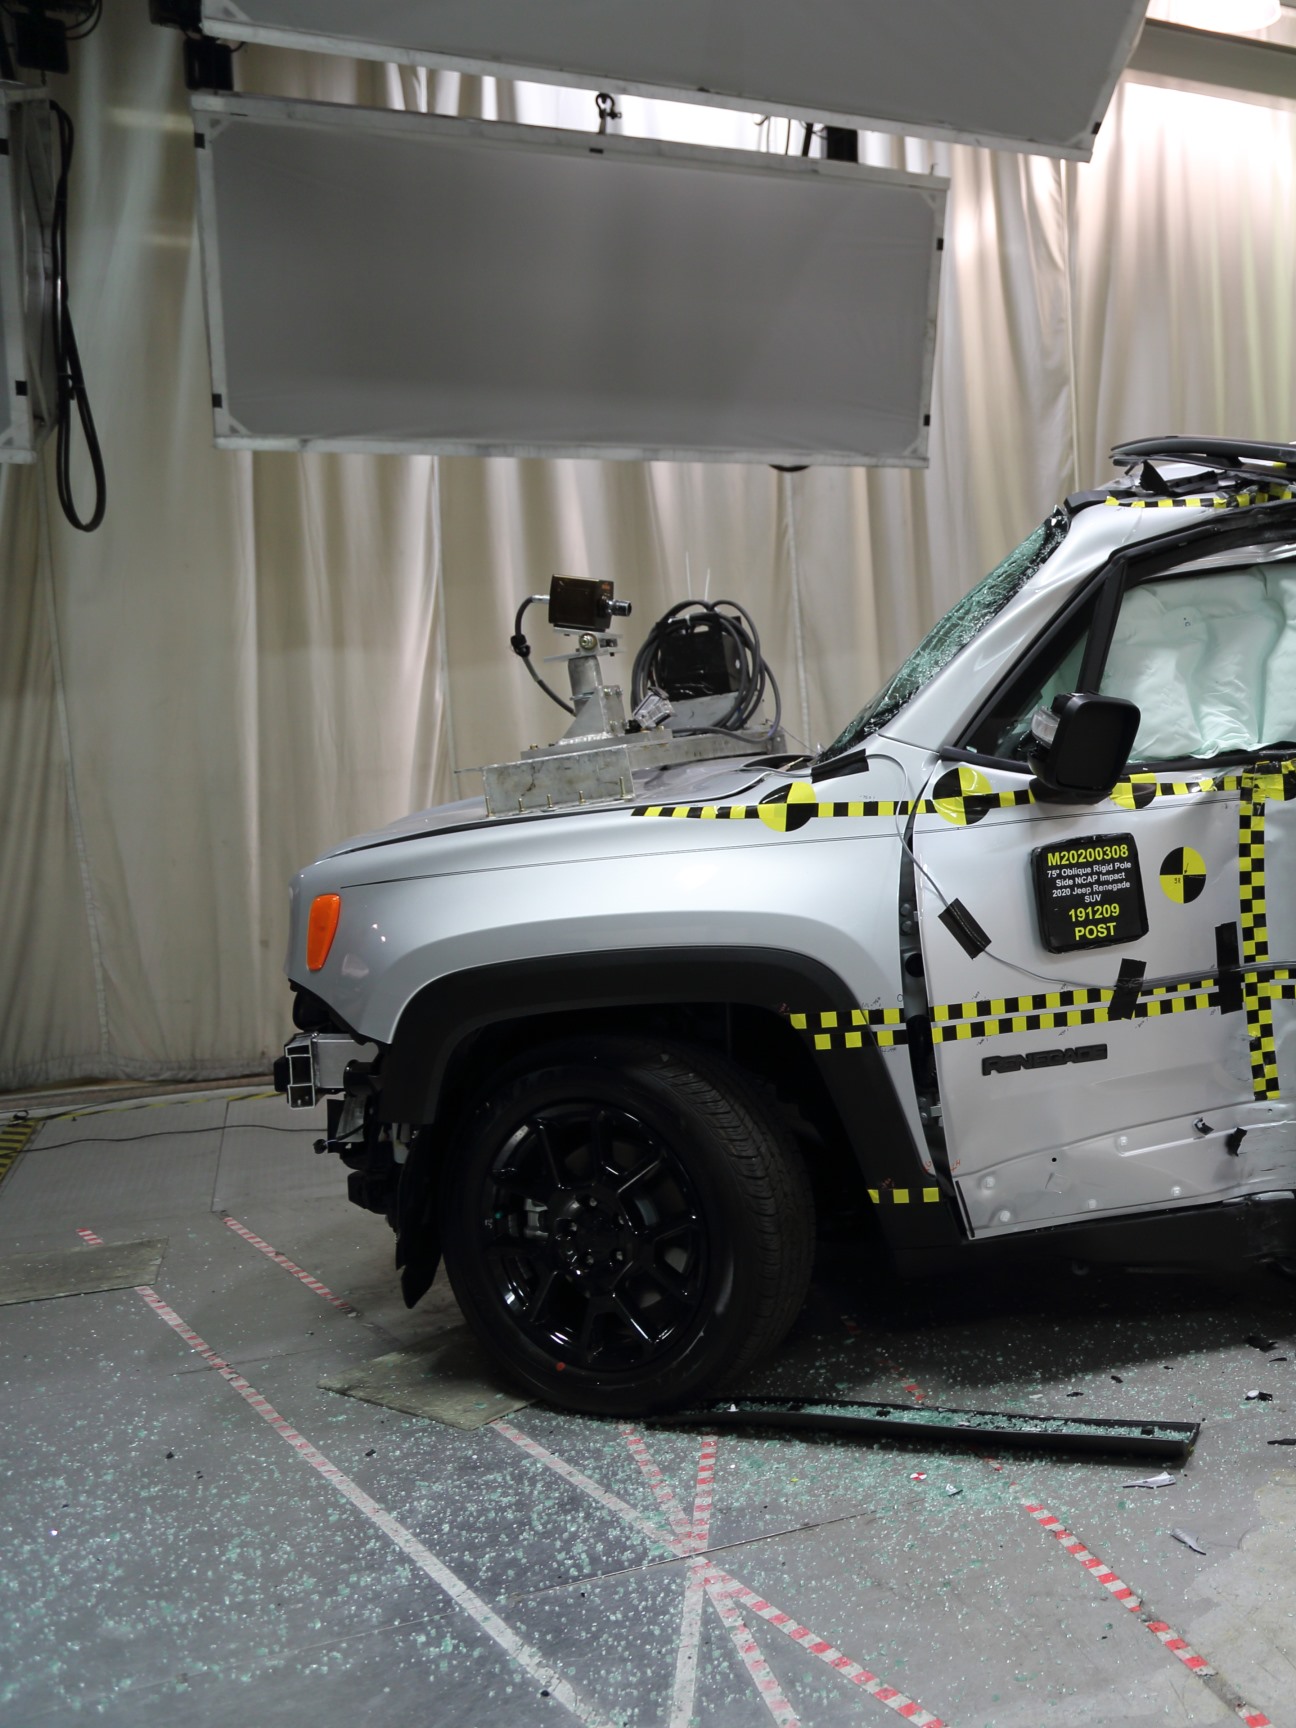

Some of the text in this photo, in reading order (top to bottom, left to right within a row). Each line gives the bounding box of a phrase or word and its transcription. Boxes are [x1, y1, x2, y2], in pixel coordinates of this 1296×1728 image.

[1047, 845, 1128, 866] M20200308
[1061, 867, 1092, 876] Oblique
[1093, 864, 1113, 873] Rigid
[1115, 861, 1132, 869] Pole
[1056, 872, 1125, 887] Side NCAP Impact
[1053, 881, 1130, 897] 2020 Jeep Renegade
[1085, 894, 1101, 903] SUV
[1069, 903, 1120, 921] 191209
[1074, 922, 1116, 940] POST
